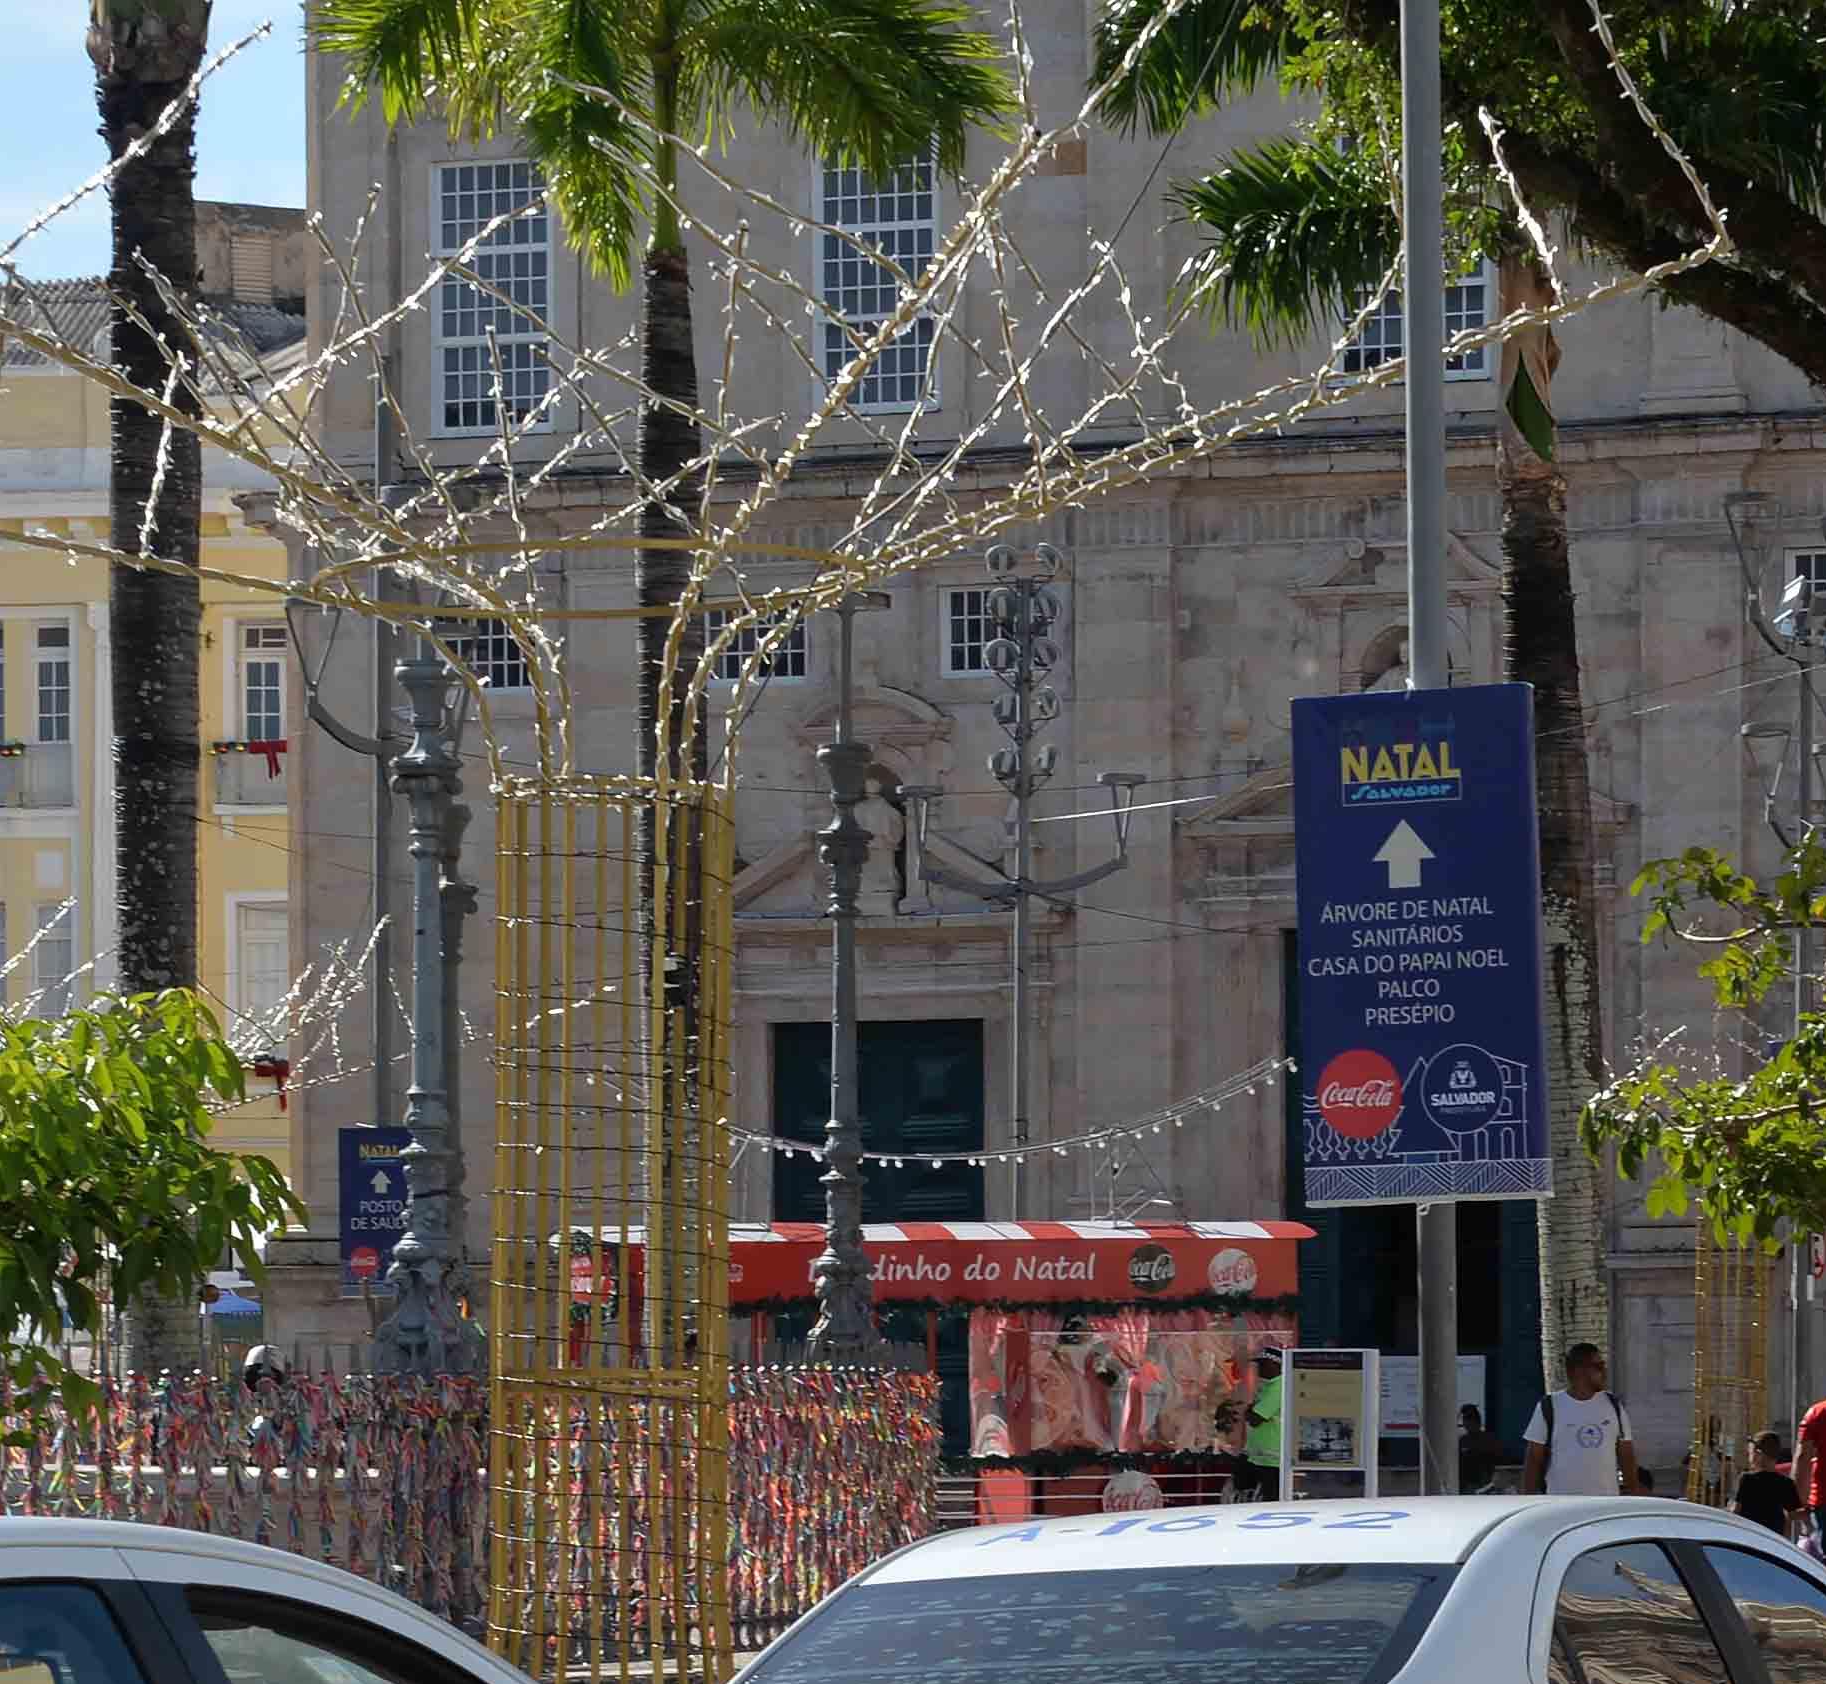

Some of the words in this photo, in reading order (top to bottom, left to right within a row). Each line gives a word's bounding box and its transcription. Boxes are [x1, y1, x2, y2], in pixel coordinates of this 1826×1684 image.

[1341, 742, 1462, 784] NATAL
[1320, 901, 1398, 923] ÁRVORE
[1402, 900, 1428, 919] DE
[1433, 896, 1495, 916] NATAL
[1351, 924, 1464, 948] SANITÁRIOS
[1307, 958, 1359, 976] CASA
[1364, 955, 1394, 974] DO
[1399, 952, 1451, 972] PAPAI
[1457, 949, 1509, 968] NOEL
[1378, 978, 1440, 998] PALCO
[1365, 1003, 1455, 1027] PRESÉPIO
[1430, 1091, 1495, 1106] SALVADOR
[359, 1200, 404, 1214] POSTO
[350, 1217, 367, 1230] DE
[371, 1214, 407, 1230] SAÚD
[964, 1253, 1000, 1281] do
[1013, 1253, 1095, 1281] Natal
[978, 1510, 1411, 1547] A-1652
